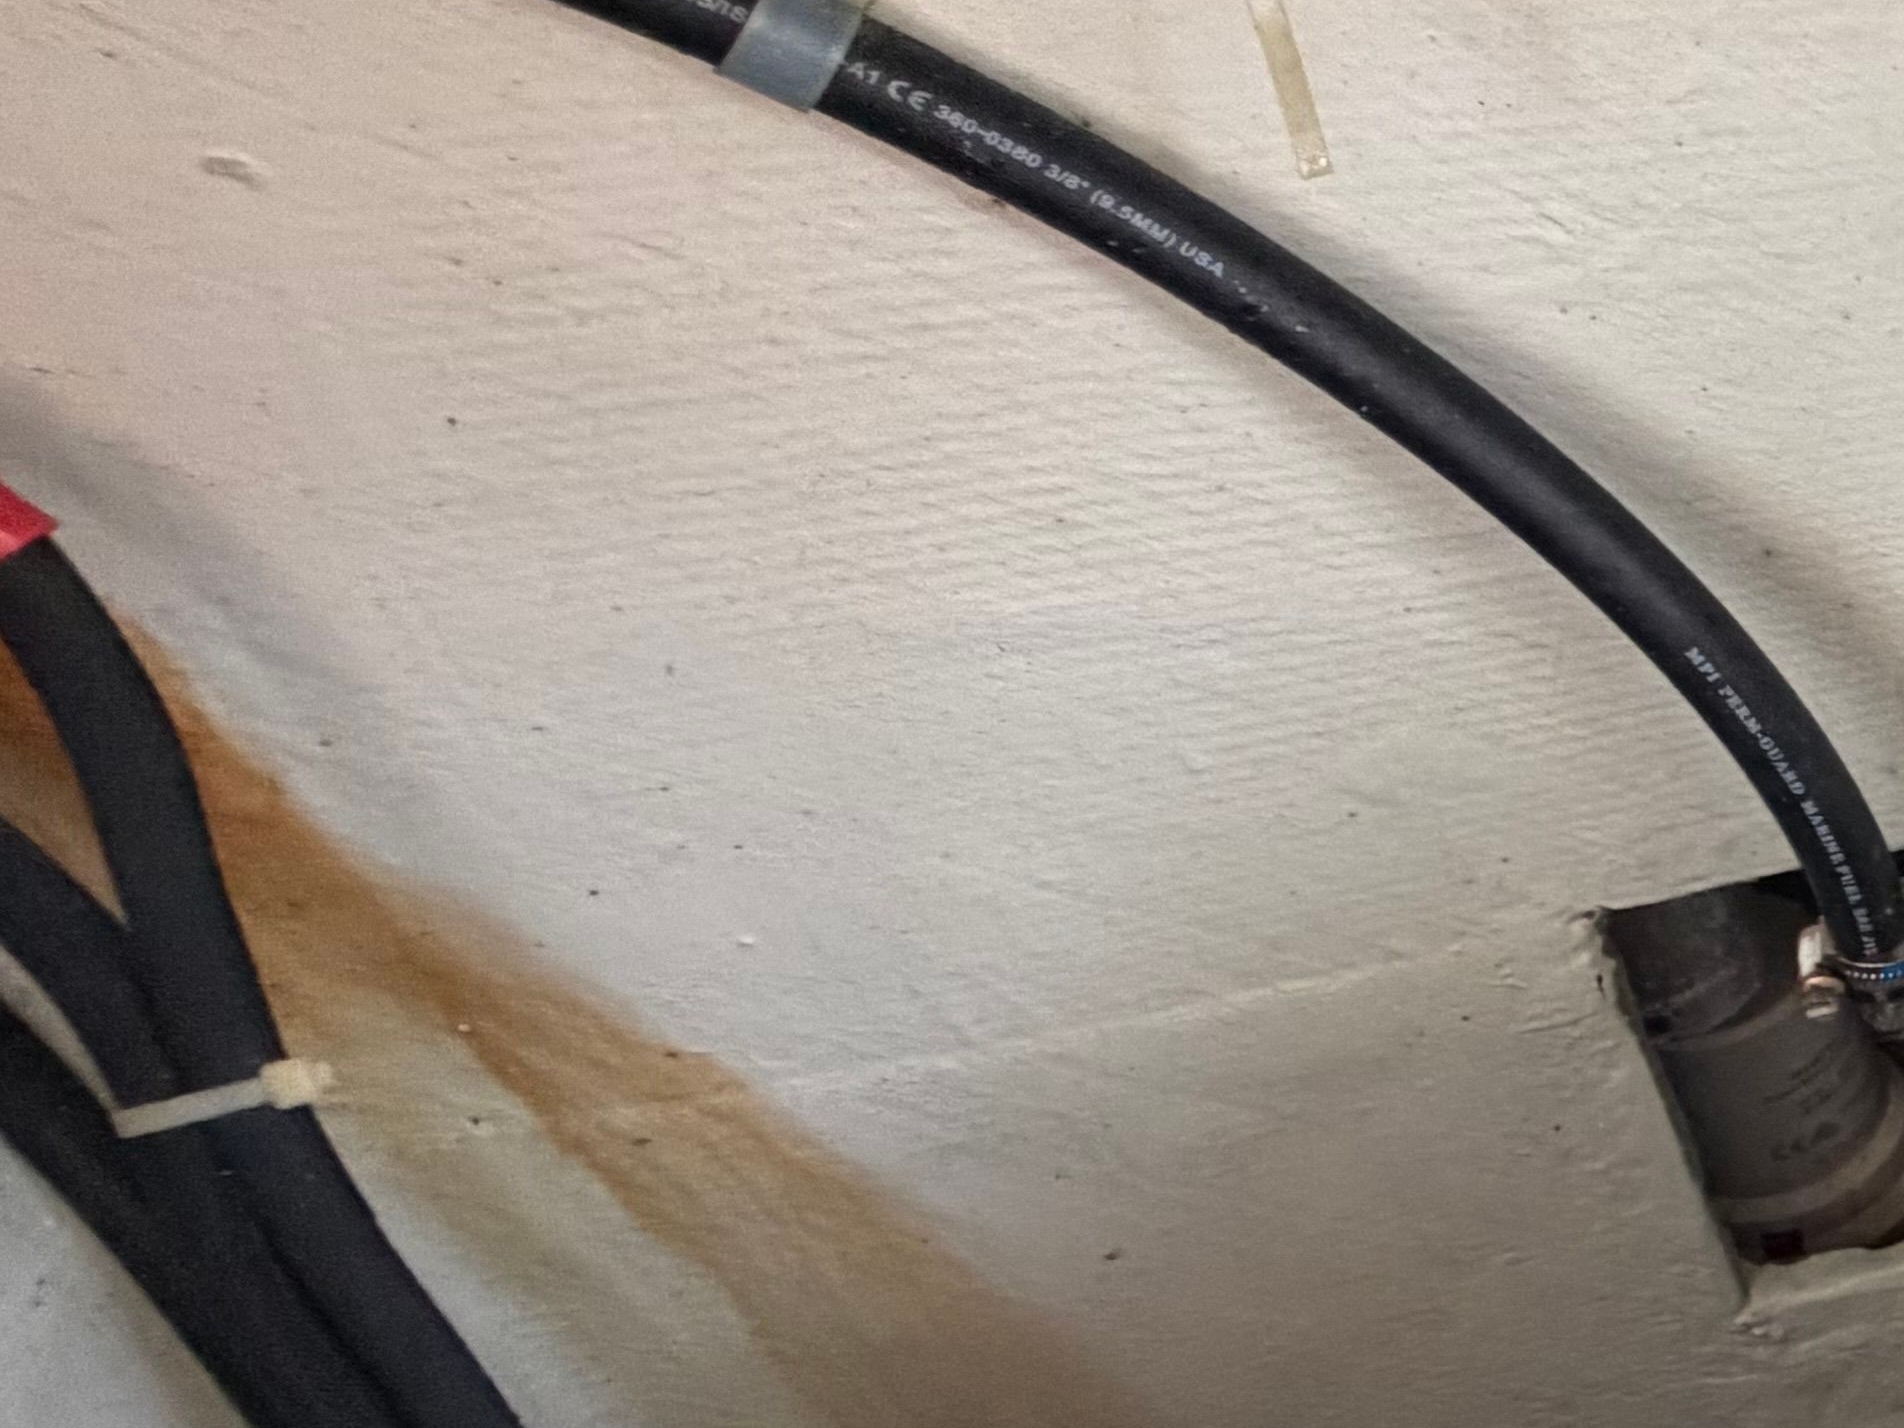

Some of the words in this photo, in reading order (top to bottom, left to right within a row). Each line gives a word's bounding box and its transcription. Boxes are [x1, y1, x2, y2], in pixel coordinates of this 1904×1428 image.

[887, 80, 933, 112] CE
[1179, 241, 1226, 279] USA
[1685, 646, 1722, 683] MPI
[1718, 684, 1806, 796] PERM-GUARD
[1801, 799, 1846, 866] MARINE
